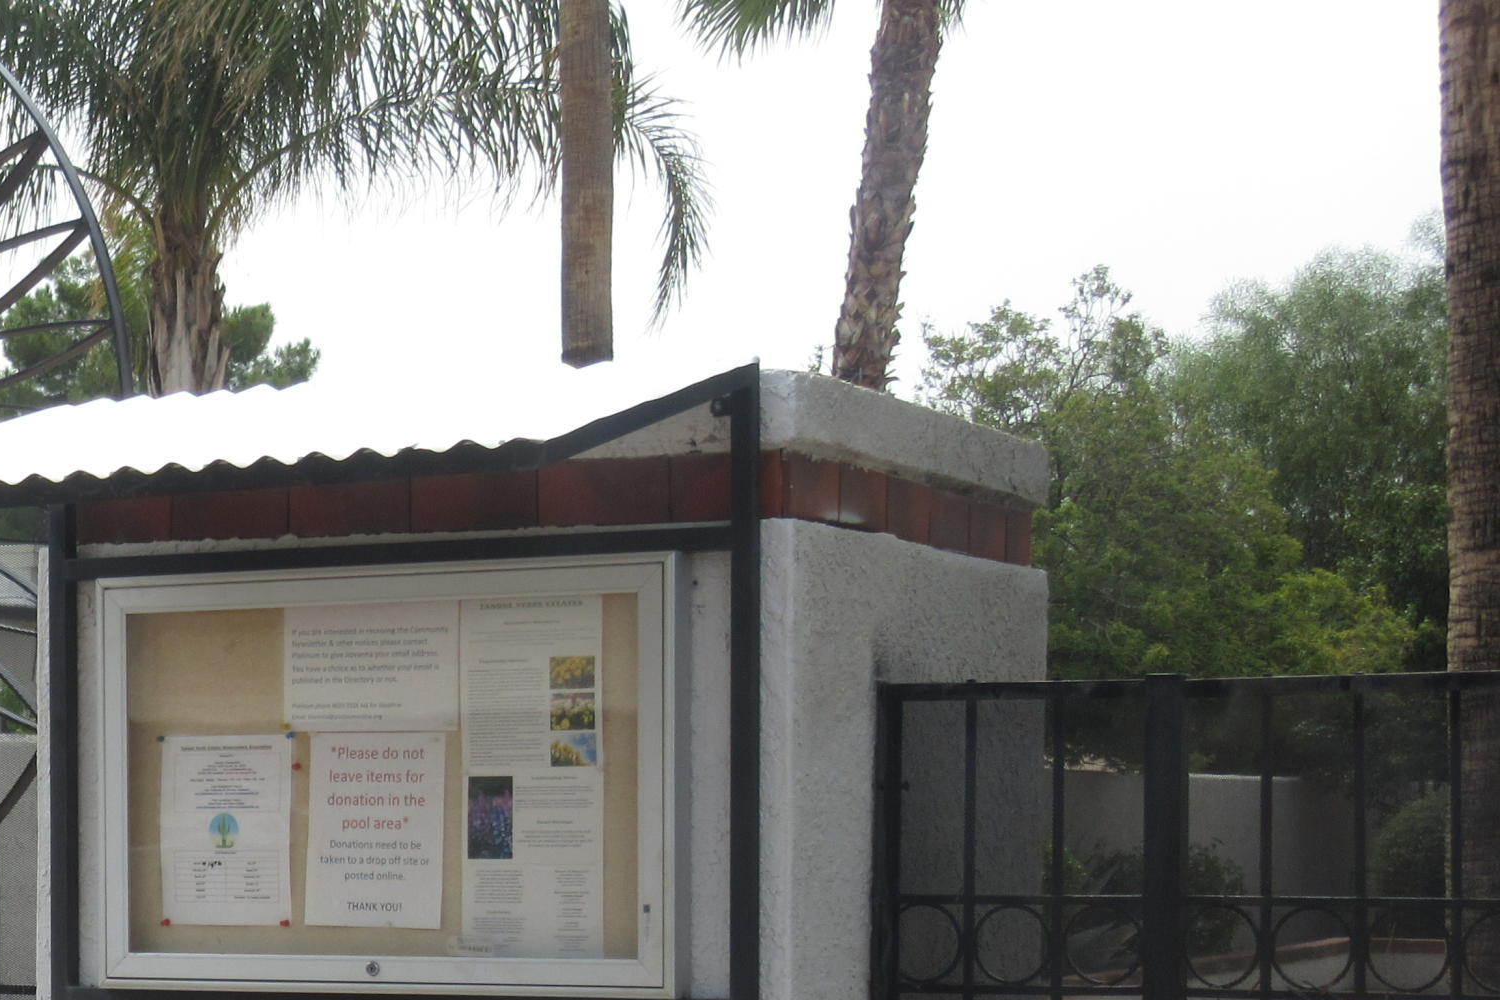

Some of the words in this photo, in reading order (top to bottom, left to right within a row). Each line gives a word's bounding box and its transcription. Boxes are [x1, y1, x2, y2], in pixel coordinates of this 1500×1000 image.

[382, 747, 399, 760] do
[402, 748, 425, 760] not
[329, 769, 363, 783] leave
[366, 770, 402, 783] items
[405, 769, 425, 783] for
[327, 793, 385, 806] donation
[388, 794, 400, 806] in
[404, 793, 426, 807] the
[342, 816, 370, 832] pool
[329, 839, 373, 849] Donations
[375, 839, 397, 849] need
[399, 840, 408, 849] to
[410, 840, 422, 850] be
[320, 855, 346, 864] taken
[347, 856, 357, 865] to
[366, 855, 387, 867] drop
[388, 856, 401, 865] off
[402, 856, 419, 866] site
[420, 858, 430, 866] or
[344, 871, 374, 882] posted
[376, 871, 407, 881] online.
[347, 901, 377, 911] THANK
[380, 902, 403, 912] YOU!
